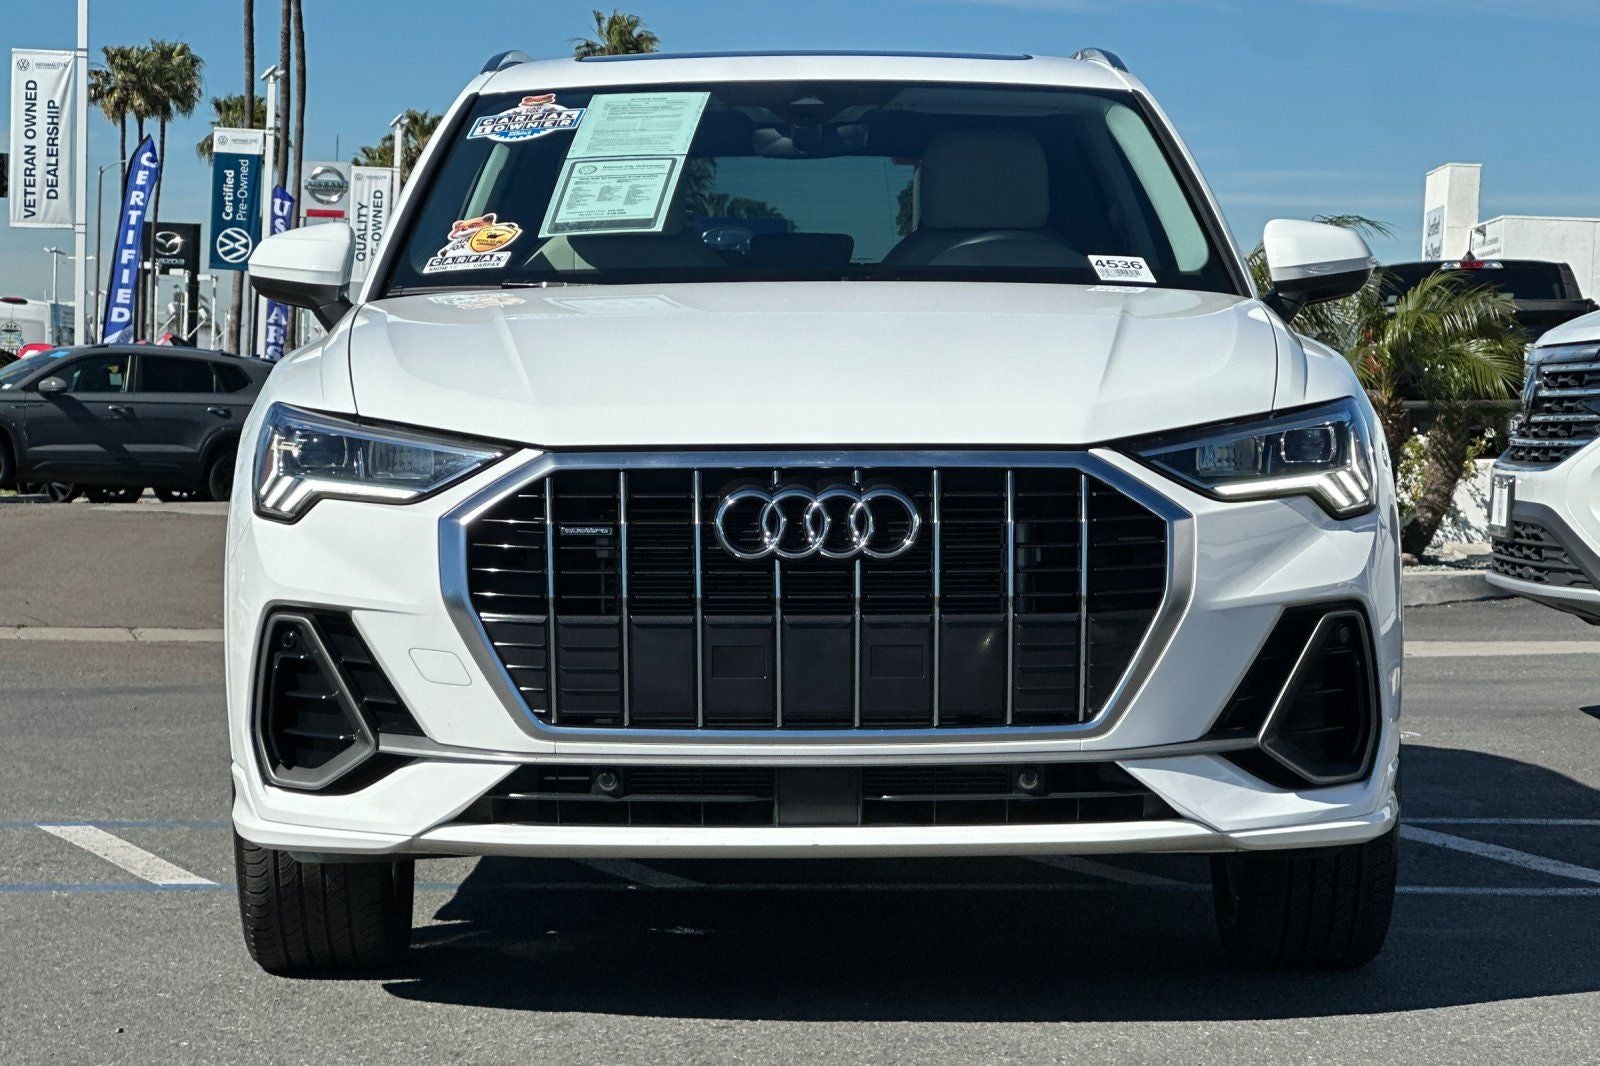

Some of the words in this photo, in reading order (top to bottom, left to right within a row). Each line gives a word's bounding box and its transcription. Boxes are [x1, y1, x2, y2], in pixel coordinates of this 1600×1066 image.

[24, 79, 38, 140] OWNED
[481, 111, 575, 125] CARFAX
[493, 120, 572, 132] OWNER
[46, 99, 60, 200] DEALERSHIP
[24, 144, 37, 219] VETERAN
[222, 169, 235, 221] Certified
[236, 159, 249, 221] Pre-Owned
[110, 151, 158, 323] CERTIFIED
[355, 202, 368, 262] QUALITY
[431, 254, 504, 267] CARFAX
[1095, 259, 1144, 270] 4536
